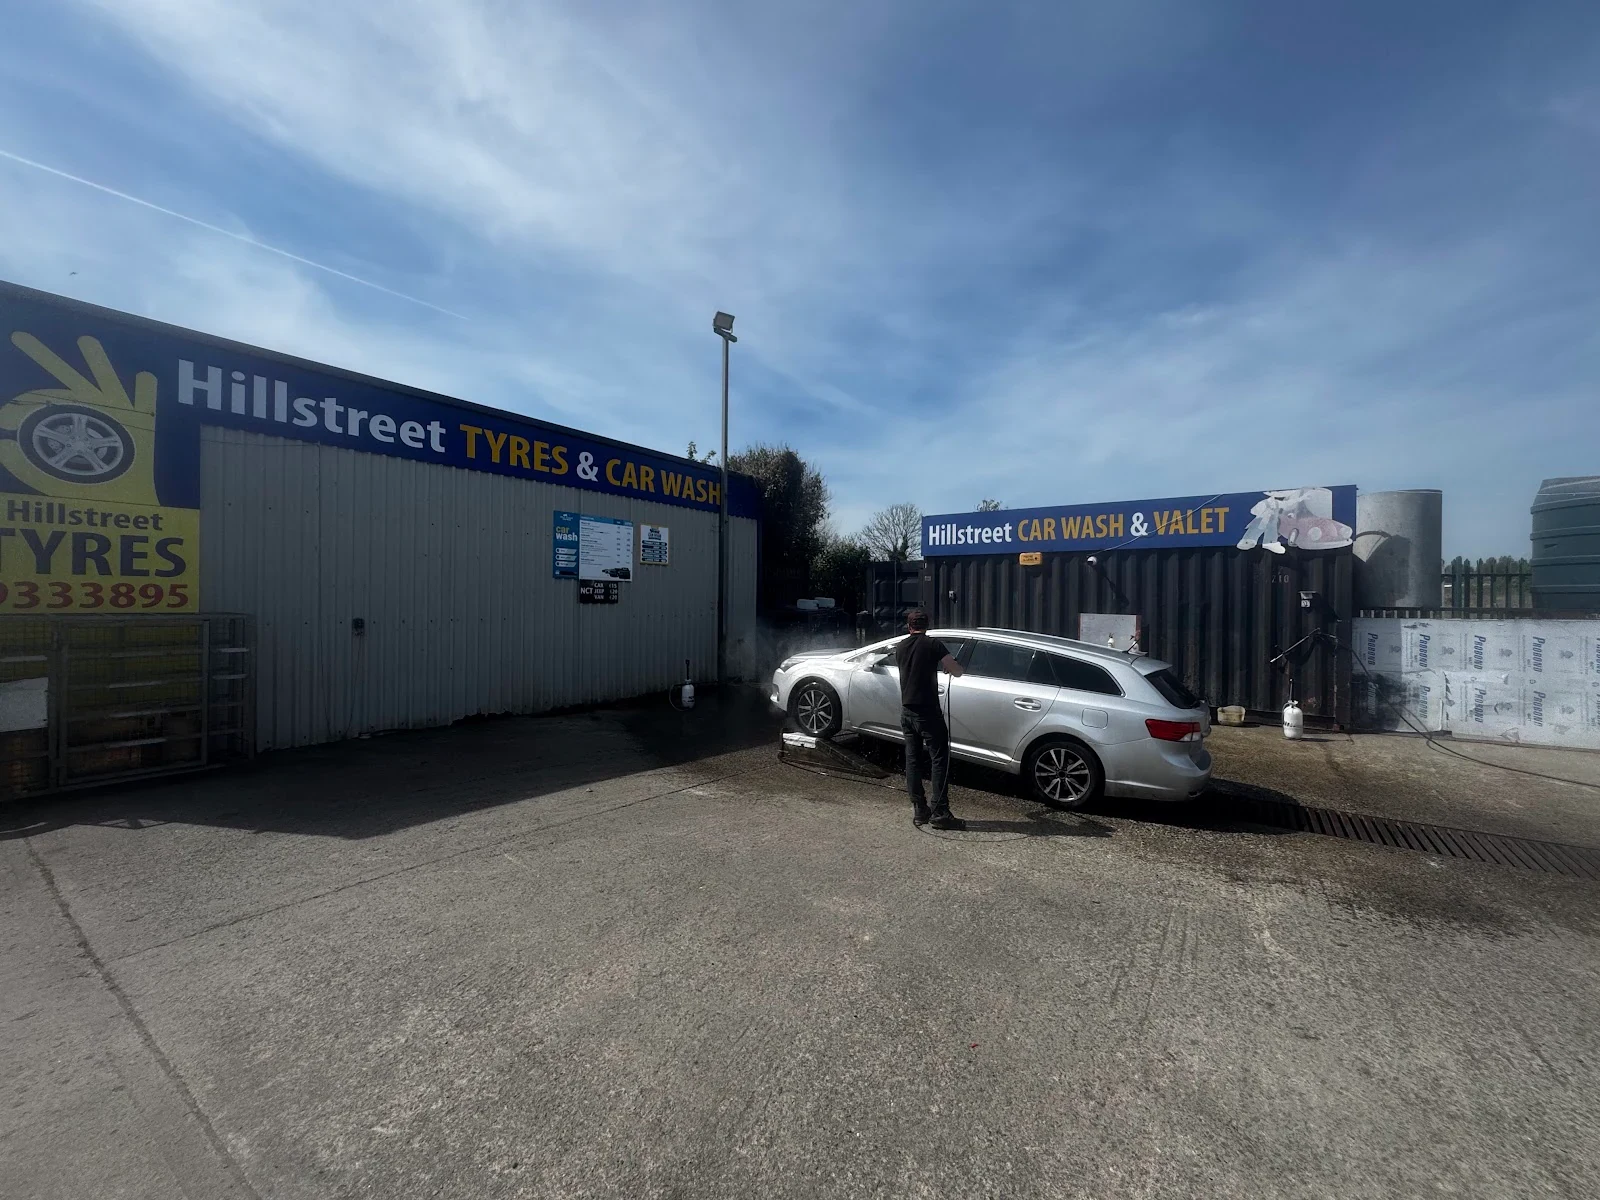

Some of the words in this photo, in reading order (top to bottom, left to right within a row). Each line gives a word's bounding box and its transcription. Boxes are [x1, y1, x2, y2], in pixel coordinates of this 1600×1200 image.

[178, 358, 446, 453] Hillstreet
[459, 423, 569, 476] TYRES
[576, 451, 599, 482] &
[605, 458, 655, 493] CAR
[660, 469, 721, 506] WASH
[7, 499, 164, 531] Hillstreet
[928, 522, 1013, 546] Hillstreet
[1017, 517, 1056, 542] CAR
[1061, 513, 1124, 540] WASH
[1130, 512, 1149, 538] &
[1153, 507, 1230, 535] VALET
[556, 532, 577, 541] wash
[580, 587, 594, 595] NCT
